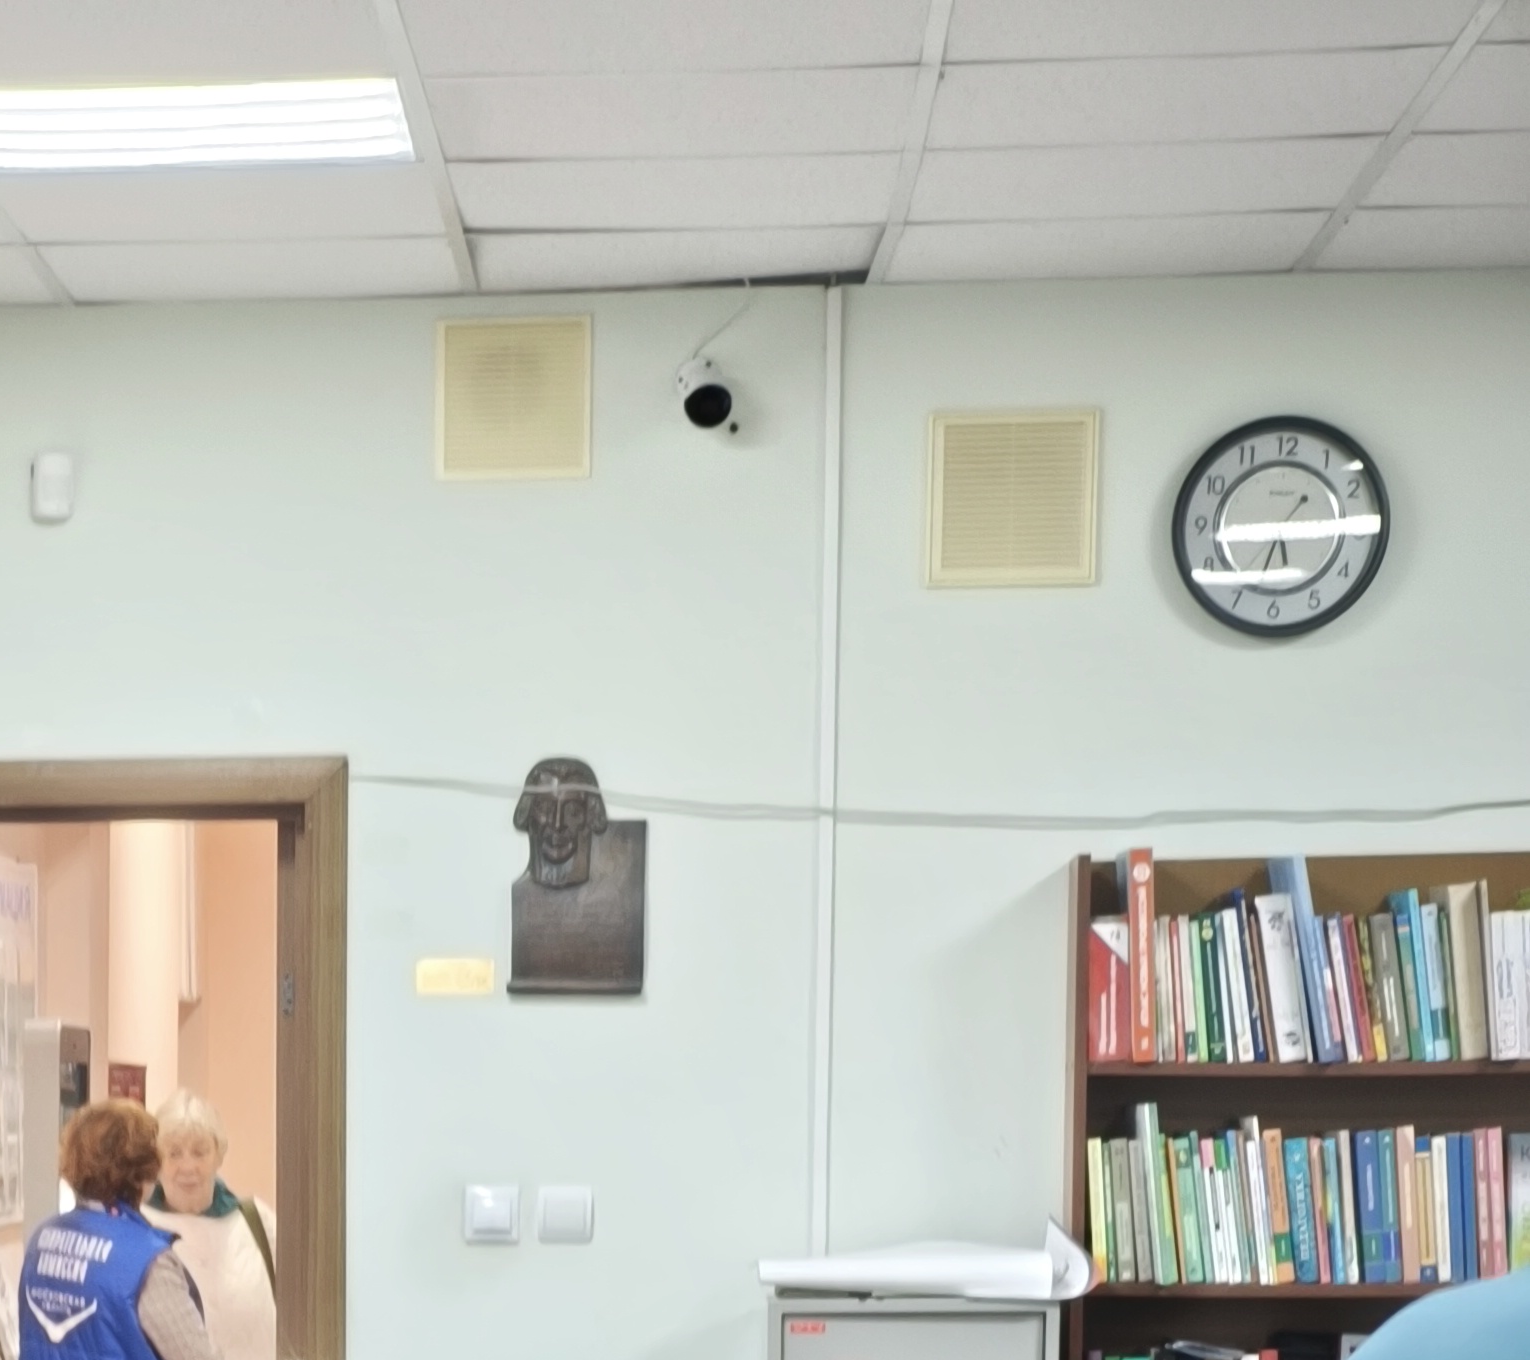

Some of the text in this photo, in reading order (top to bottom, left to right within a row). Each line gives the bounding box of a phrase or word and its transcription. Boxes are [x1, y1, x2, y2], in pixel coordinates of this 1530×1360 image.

[1237, 444, 1256, 466] 11
[1276, 435, 1299, 457] 12
[1322, 448, 1330, 469] 1
[1205, 474, 1225, 496] 10
[1347, 477, 1362, 499] 2
[1194, 515, 1208, 536] 9
[1337, 560, 1349, 579] 4
[1230, 589, 1243, 610] 7
[1266, 598, 1280, 620] 6
[1307, 589, 1321, 610] 5
